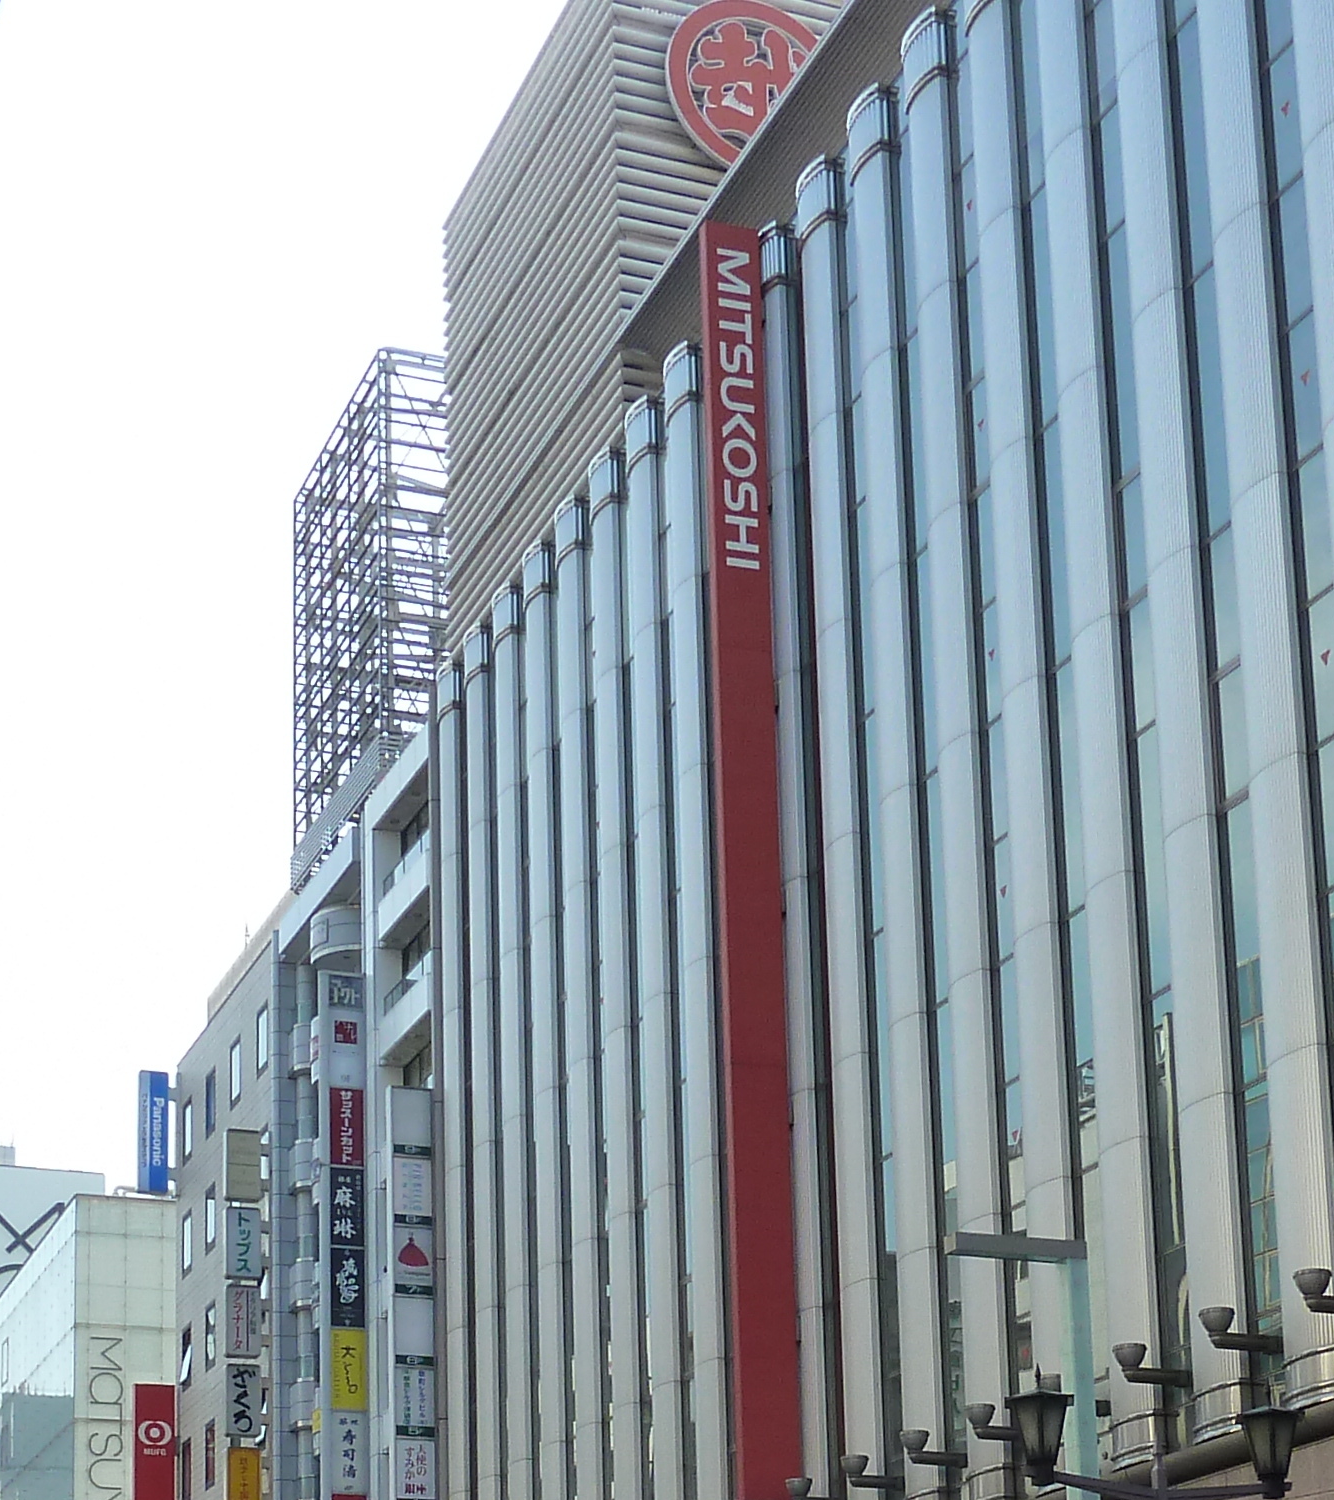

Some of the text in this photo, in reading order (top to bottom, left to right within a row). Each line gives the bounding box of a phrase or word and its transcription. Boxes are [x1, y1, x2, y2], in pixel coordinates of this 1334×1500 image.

[715, 246, 761, 571] MITSUKOSHI
[152, 1096, 166, 1167] Panasonic
[236, 1211, 252, 1273] トップス
[232, 1367, 256, 1434] ざくろ
[404, 1446, 416, 1480] すみか
